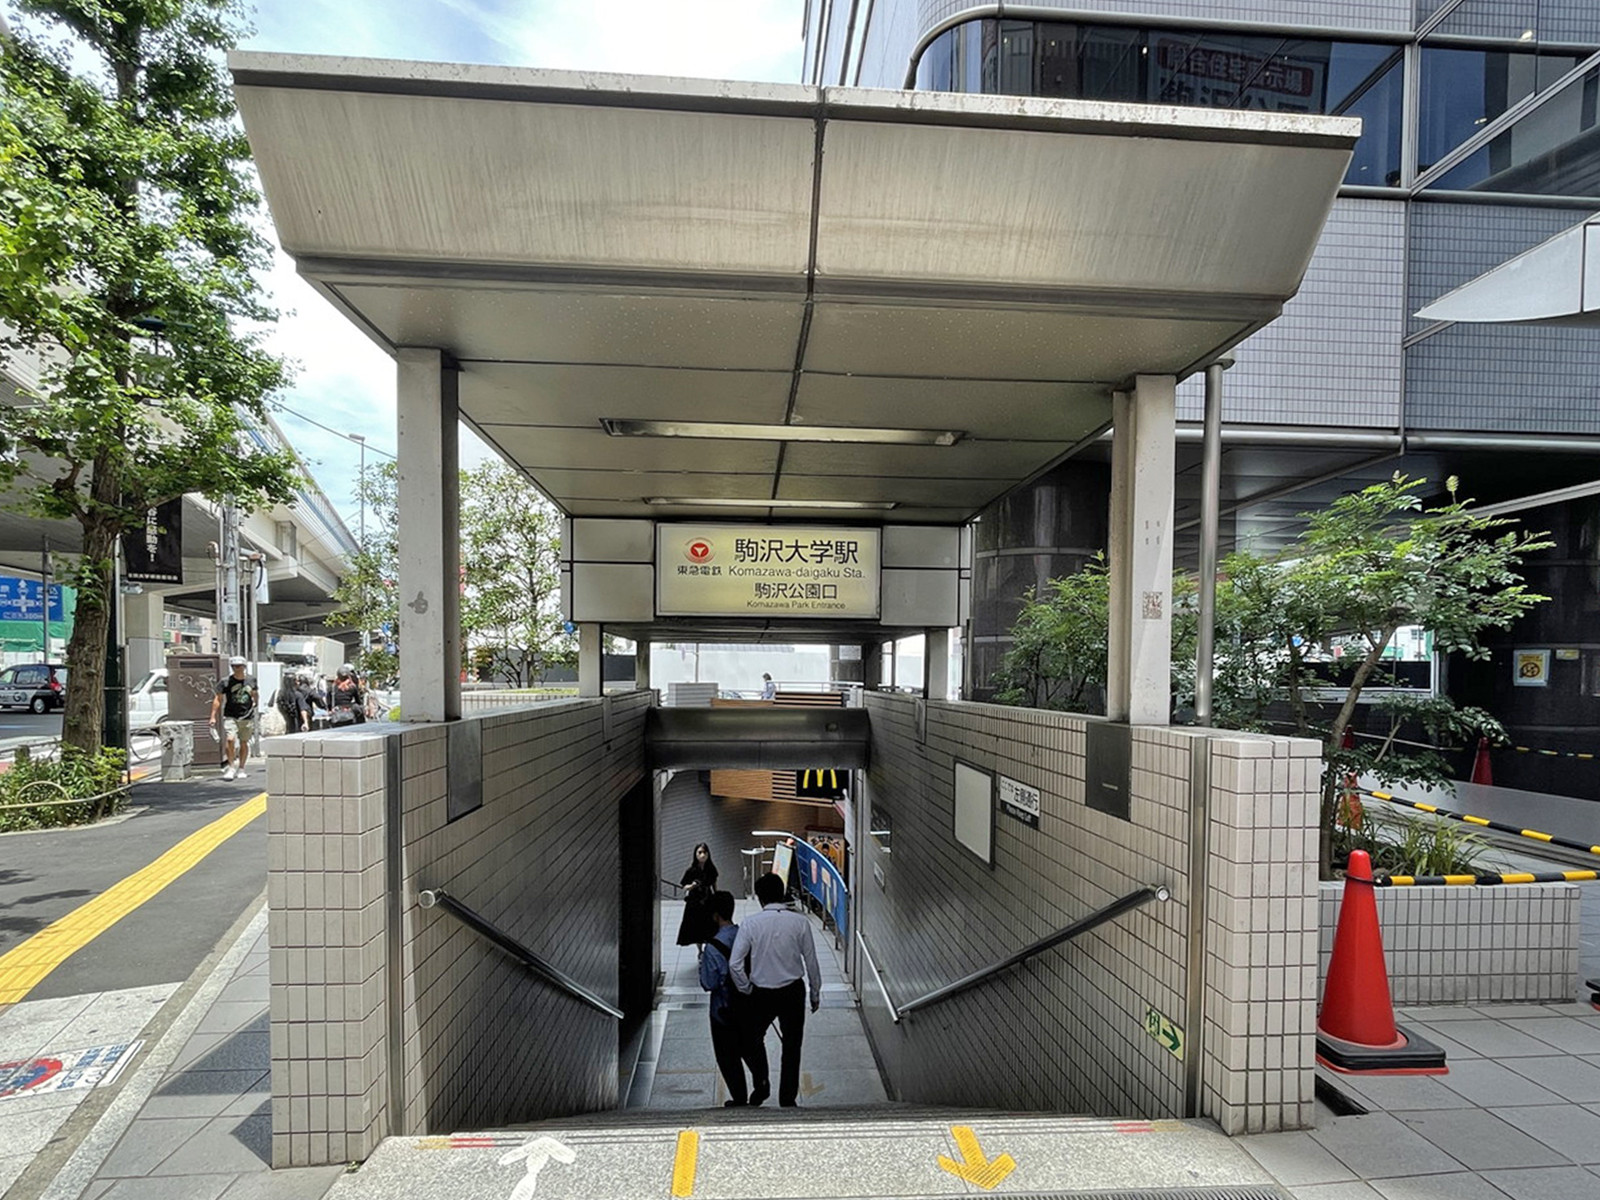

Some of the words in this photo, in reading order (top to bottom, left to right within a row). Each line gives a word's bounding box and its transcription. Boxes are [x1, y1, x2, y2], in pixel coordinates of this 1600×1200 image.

[734, 538, 859, 564] 駒沢大学駅
[677, 565, 723, 576] 東急電鉄
[728, 566, 840, 580] Komazawa-daigaku
[843, 567, 866, 578] Sta.
[754, 583, 838, 600] 駒沢公園口
[746, 600, 790, 609] Komazawa
[791, 600, 810, 609] Park
[811, 601, 846, 610] Entrance
